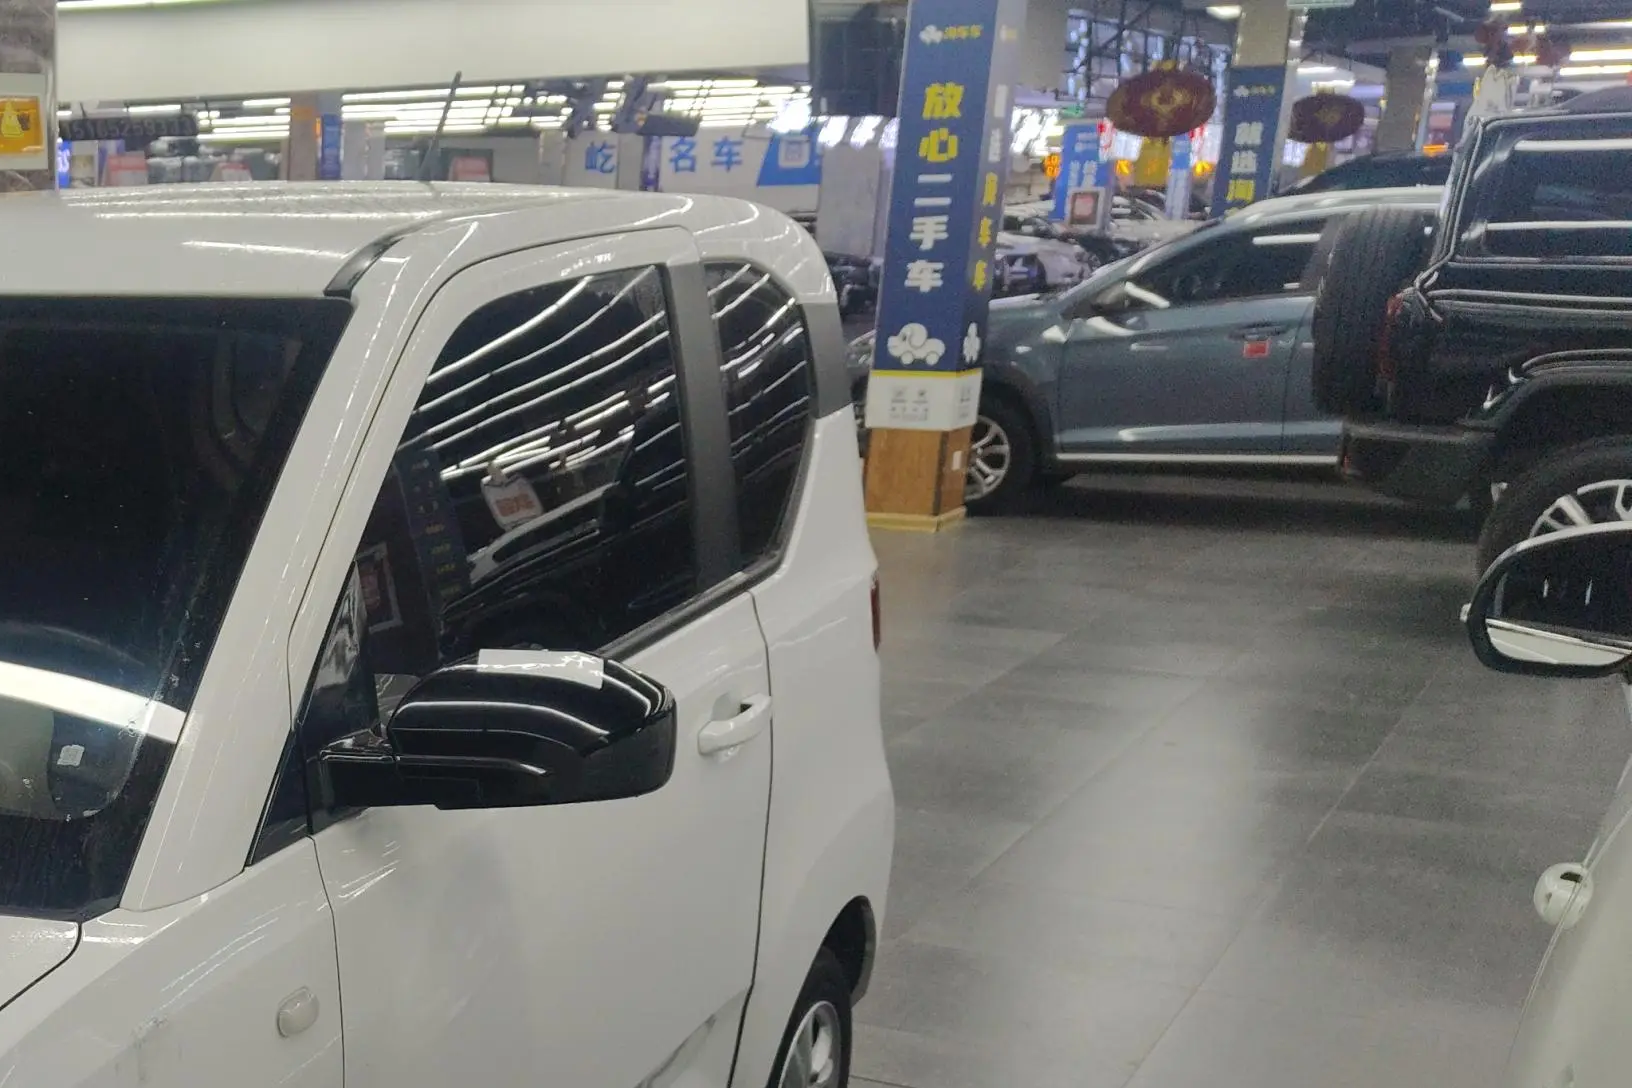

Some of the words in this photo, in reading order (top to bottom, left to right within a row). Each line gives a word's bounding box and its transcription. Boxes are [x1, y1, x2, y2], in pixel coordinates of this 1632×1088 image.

[904, 82, 965, 293] 放心二手车
